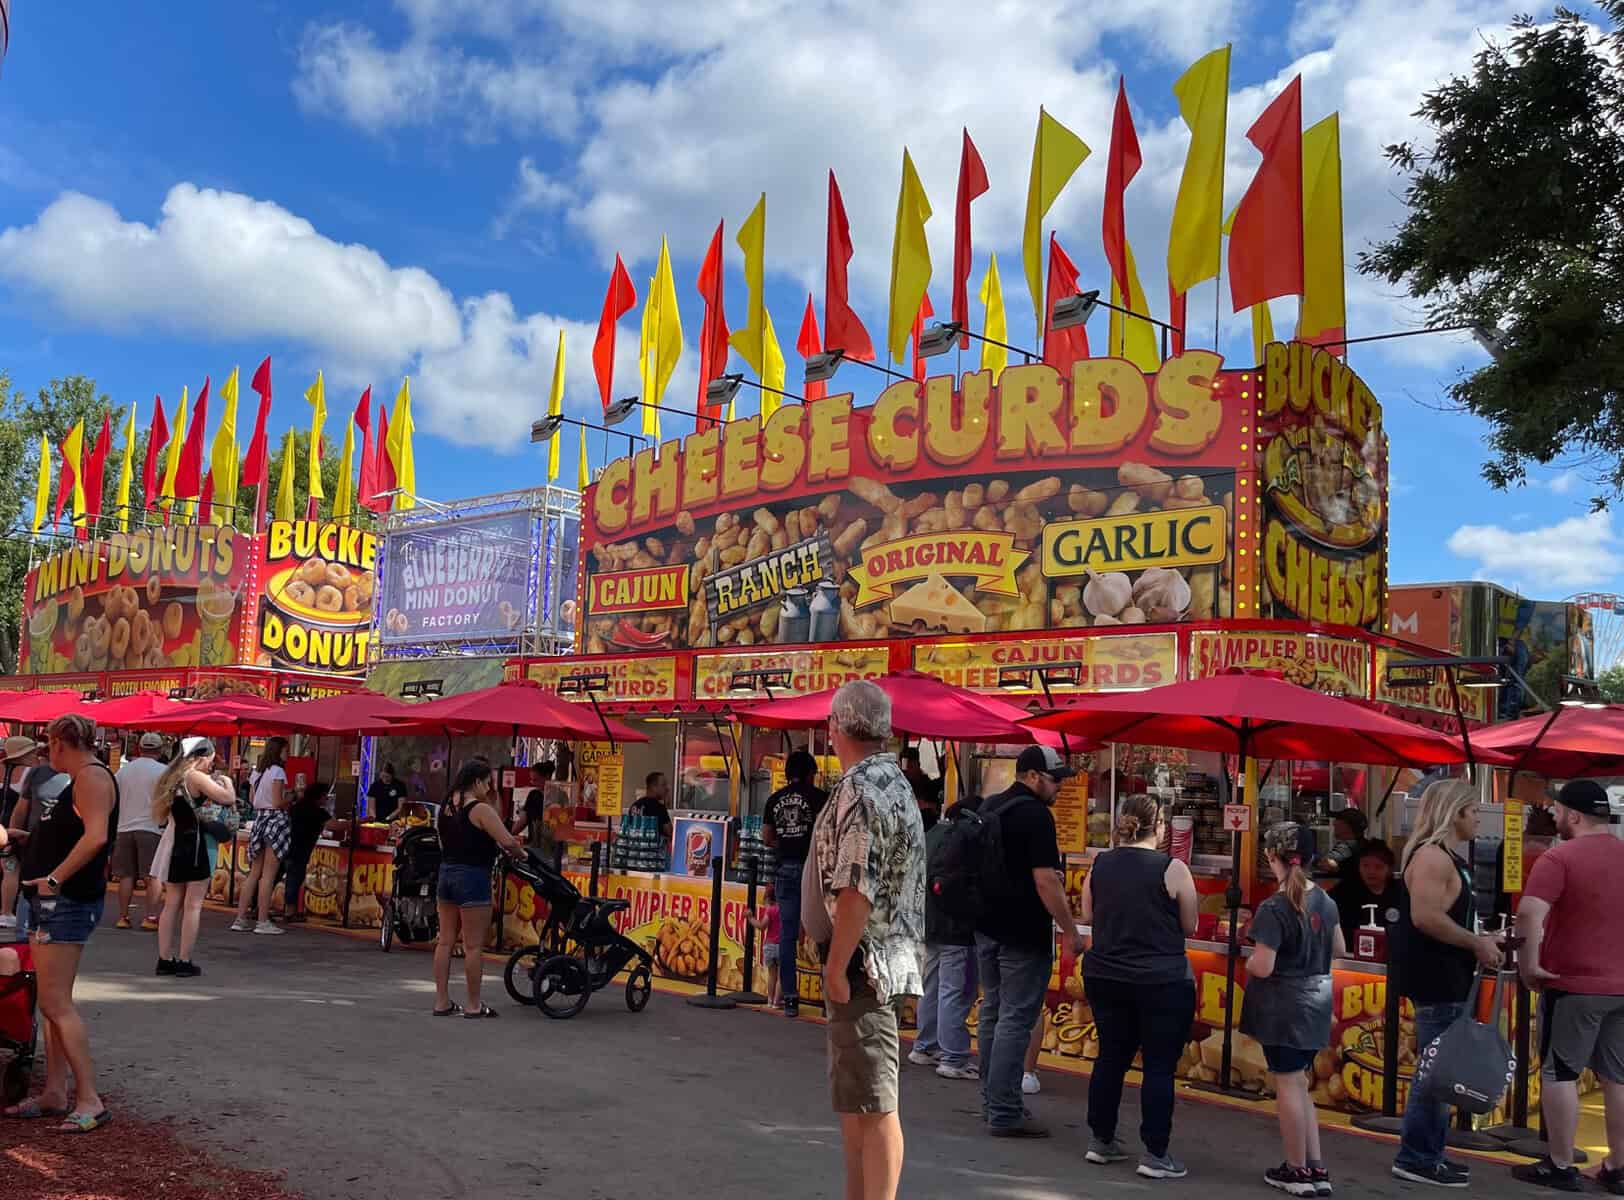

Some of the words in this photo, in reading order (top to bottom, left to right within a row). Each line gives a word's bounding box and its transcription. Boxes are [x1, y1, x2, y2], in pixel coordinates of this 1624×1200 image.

[594, 392, 853, 534] CHEESE
[865, 349, 1224, 471] CURDS
[269, 520, 376, 571] BUCKE
[867, 540, 1004, 578] ORIGINAL
[1052, 516, 1214, 567] GARLIC
[35, 536, 103, 602] MINI
[108, 526, 236, 586] DONUTS
[715, 542, 825, 615] RANCH
[1265, 519, 1378, 625] CHEESE
[406, 589, 438, 610] MINI
[445, 582, 502, 607] DONUT
[600, 573, 677, 606] CAJUN
[422, 613, 480, 628] FACTORY
[570, 665, 627, 677] GARLIC
[751, 655, 824, 671] RANCH
[991, 644, 1084, 663] CAJUN
[1200, 638, 1297, 678] SAMPLER
[1304, 639, 1363, 691] BUCKET
[607, 679, 668, 696] CURDS
[1435, 687, 1477, 713] CUDS
[615, 886, 692, 935] SAMPLER
[698, 896, 768, 967] BCKT
